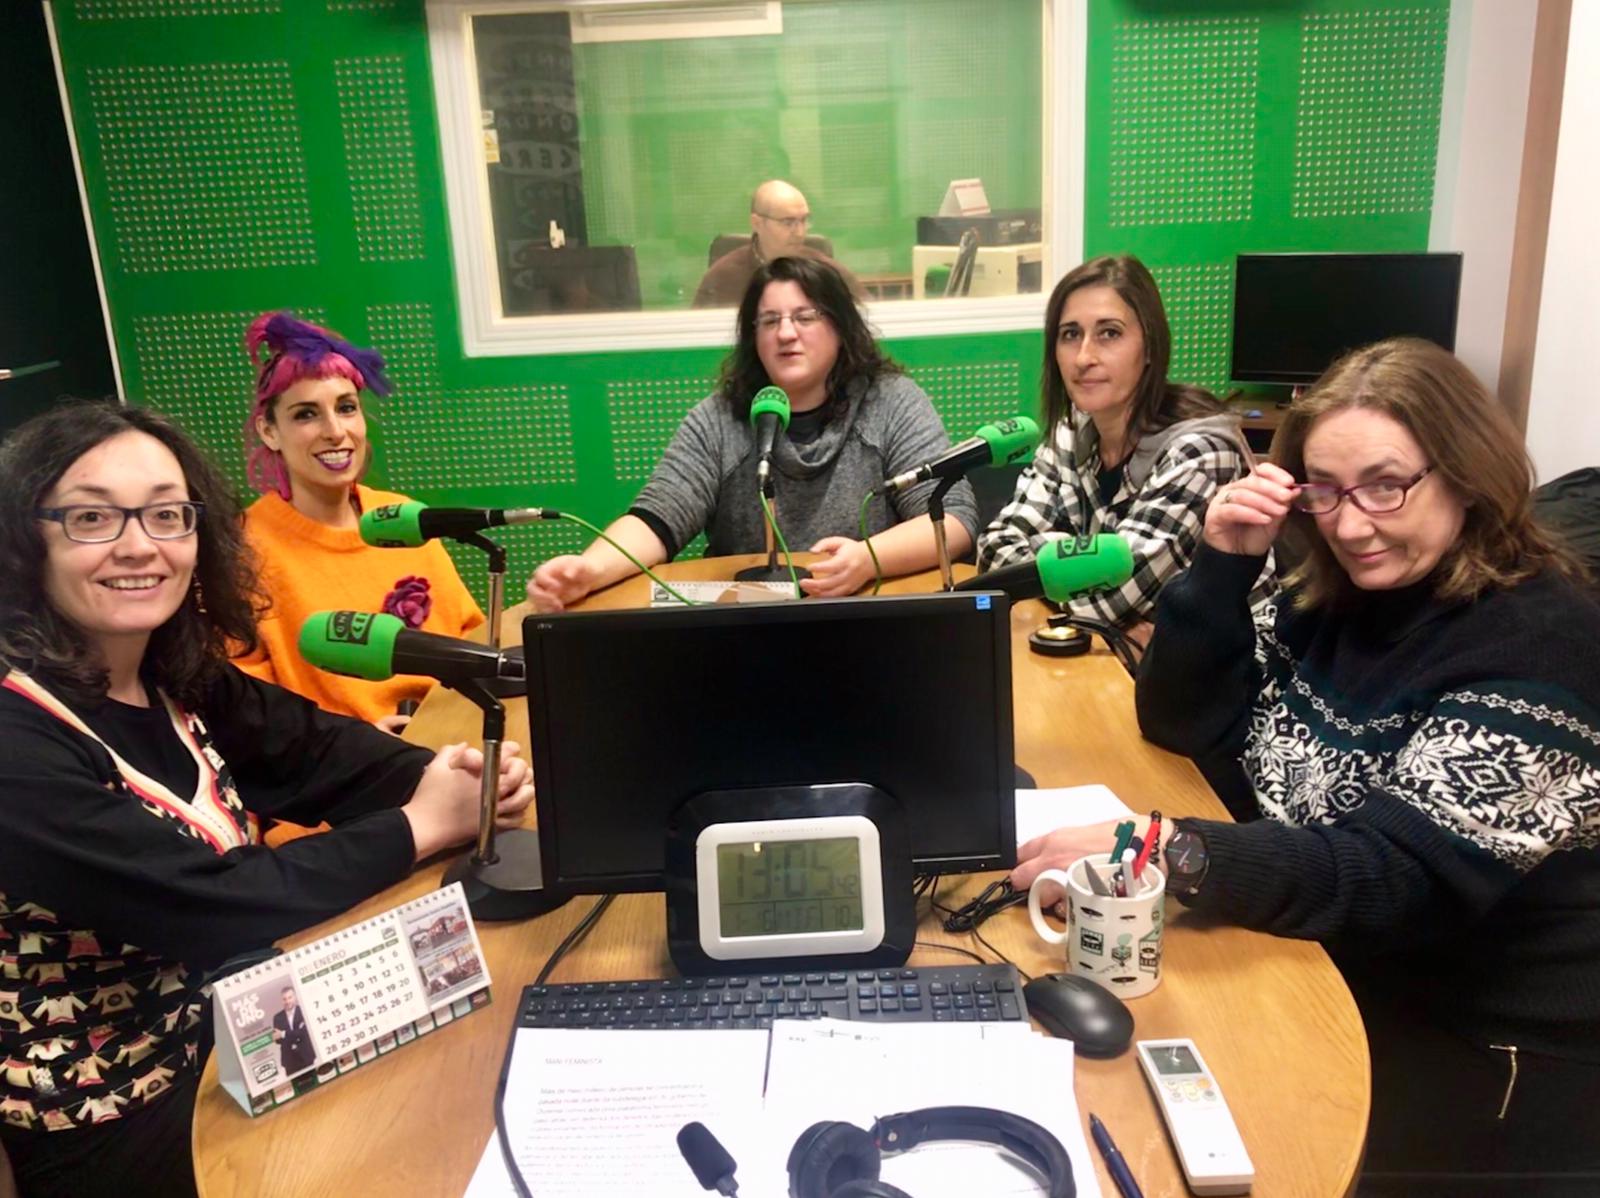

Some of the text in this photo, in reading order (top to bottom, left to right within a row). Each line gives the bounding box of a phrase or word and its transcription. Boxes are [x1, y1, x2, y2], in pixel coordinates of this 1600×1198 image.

[313, 948, 346, 969] ENERO
[338, 974, 344, 982] 2
[352, 968, 358, 976] 3
[379, 956, 385, 964] 5
[313, 1001, 319, 1009] 7
[354, 981, 365, 990] 10
[368, 975, 378, 984] 11
[382, 969, 391, 978] 12
[395, 963, 405, 972] 13
[316, 977, 410, 1024] 14 15 16 17 18 19 20
[322, 991, 414, 1039] 21 22 23 24 25 26 27
[326, 1025, 379, 1055] 28 29 30 31
